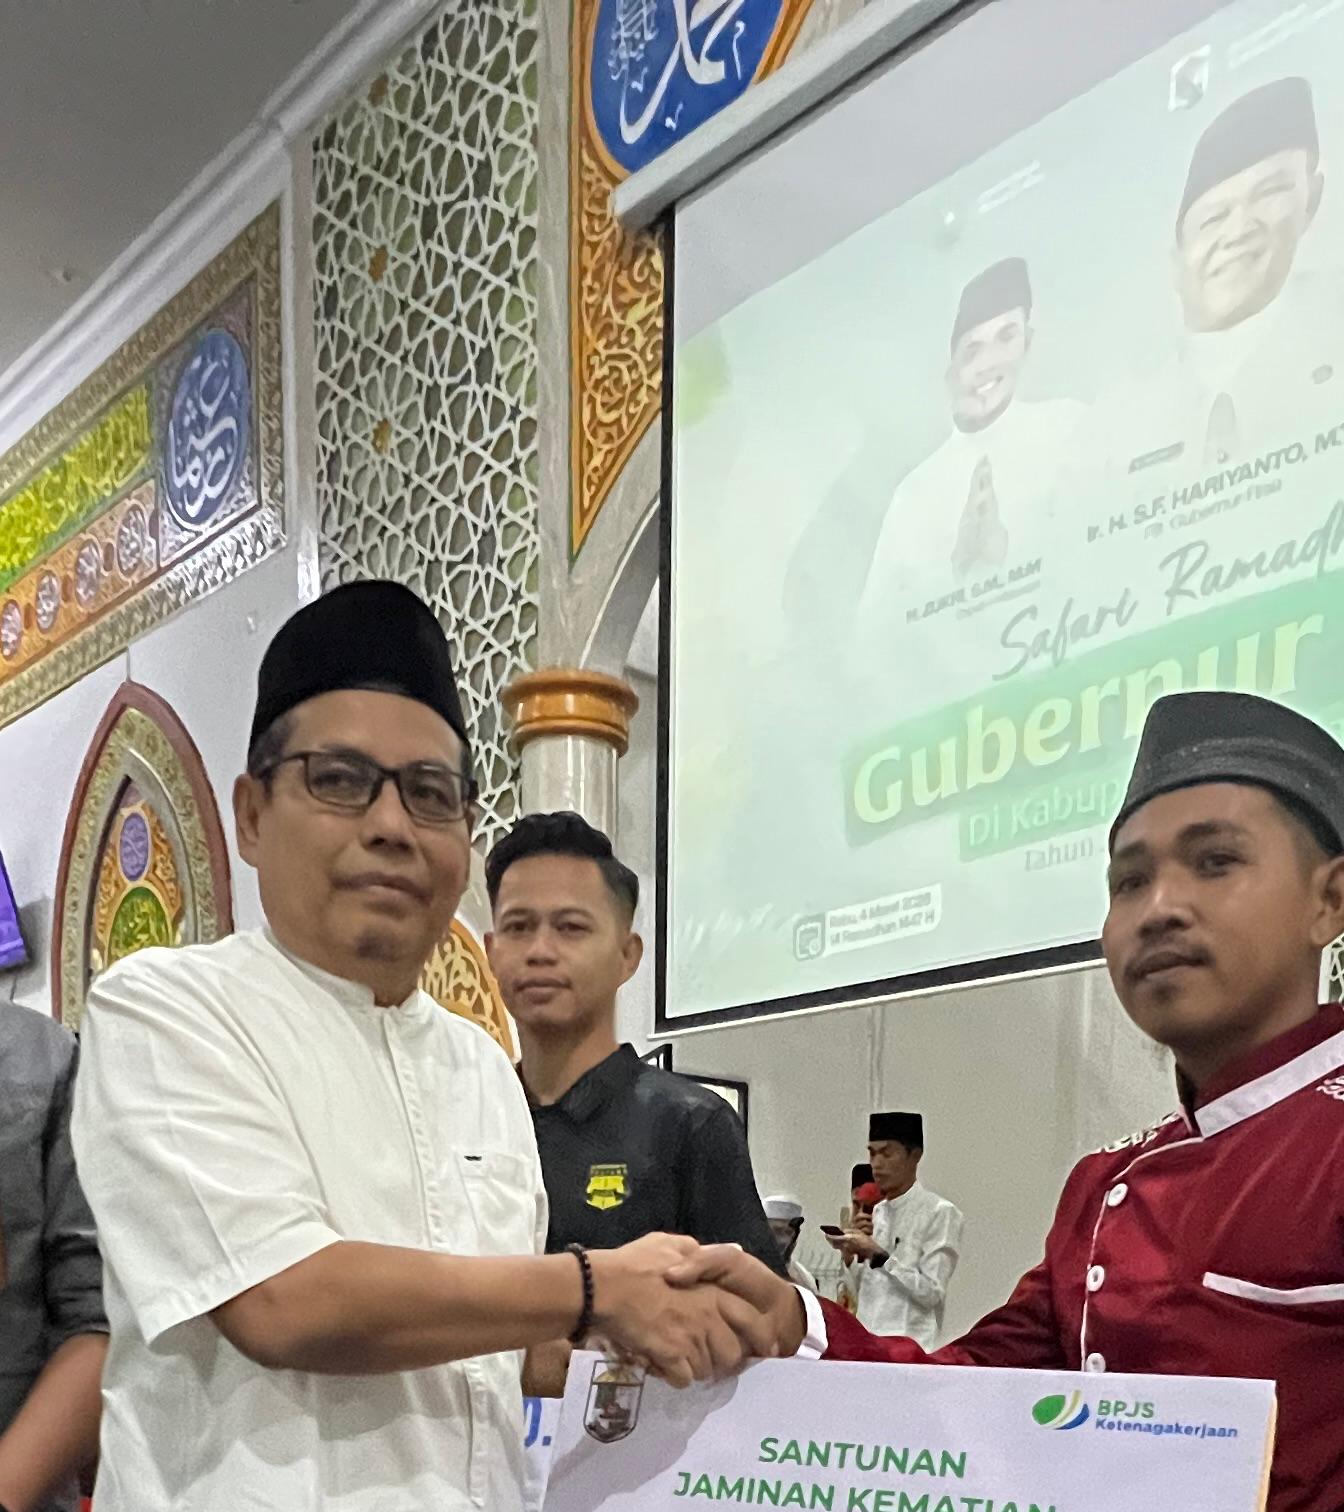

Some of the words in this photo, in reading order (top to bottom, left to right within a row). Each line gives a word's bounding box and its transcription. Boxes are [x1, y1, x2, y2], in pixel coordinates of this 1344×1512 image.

[1171, 441, 1308, 511] HARIYANTO,
[992, 586, 1141, 682] Safari
[852, 610, 1324, 825] Gubernur
[1010, 780, 1122, 840] Kabup
[1095, 1418, 1239, 1439] Ketenagakerjaan
[1097, 1399, 1155, 1419] BPJS
[759, 1437, 967, 1479] SANTUNAN
[673, 1471, 833, 1512] JAMINAN
